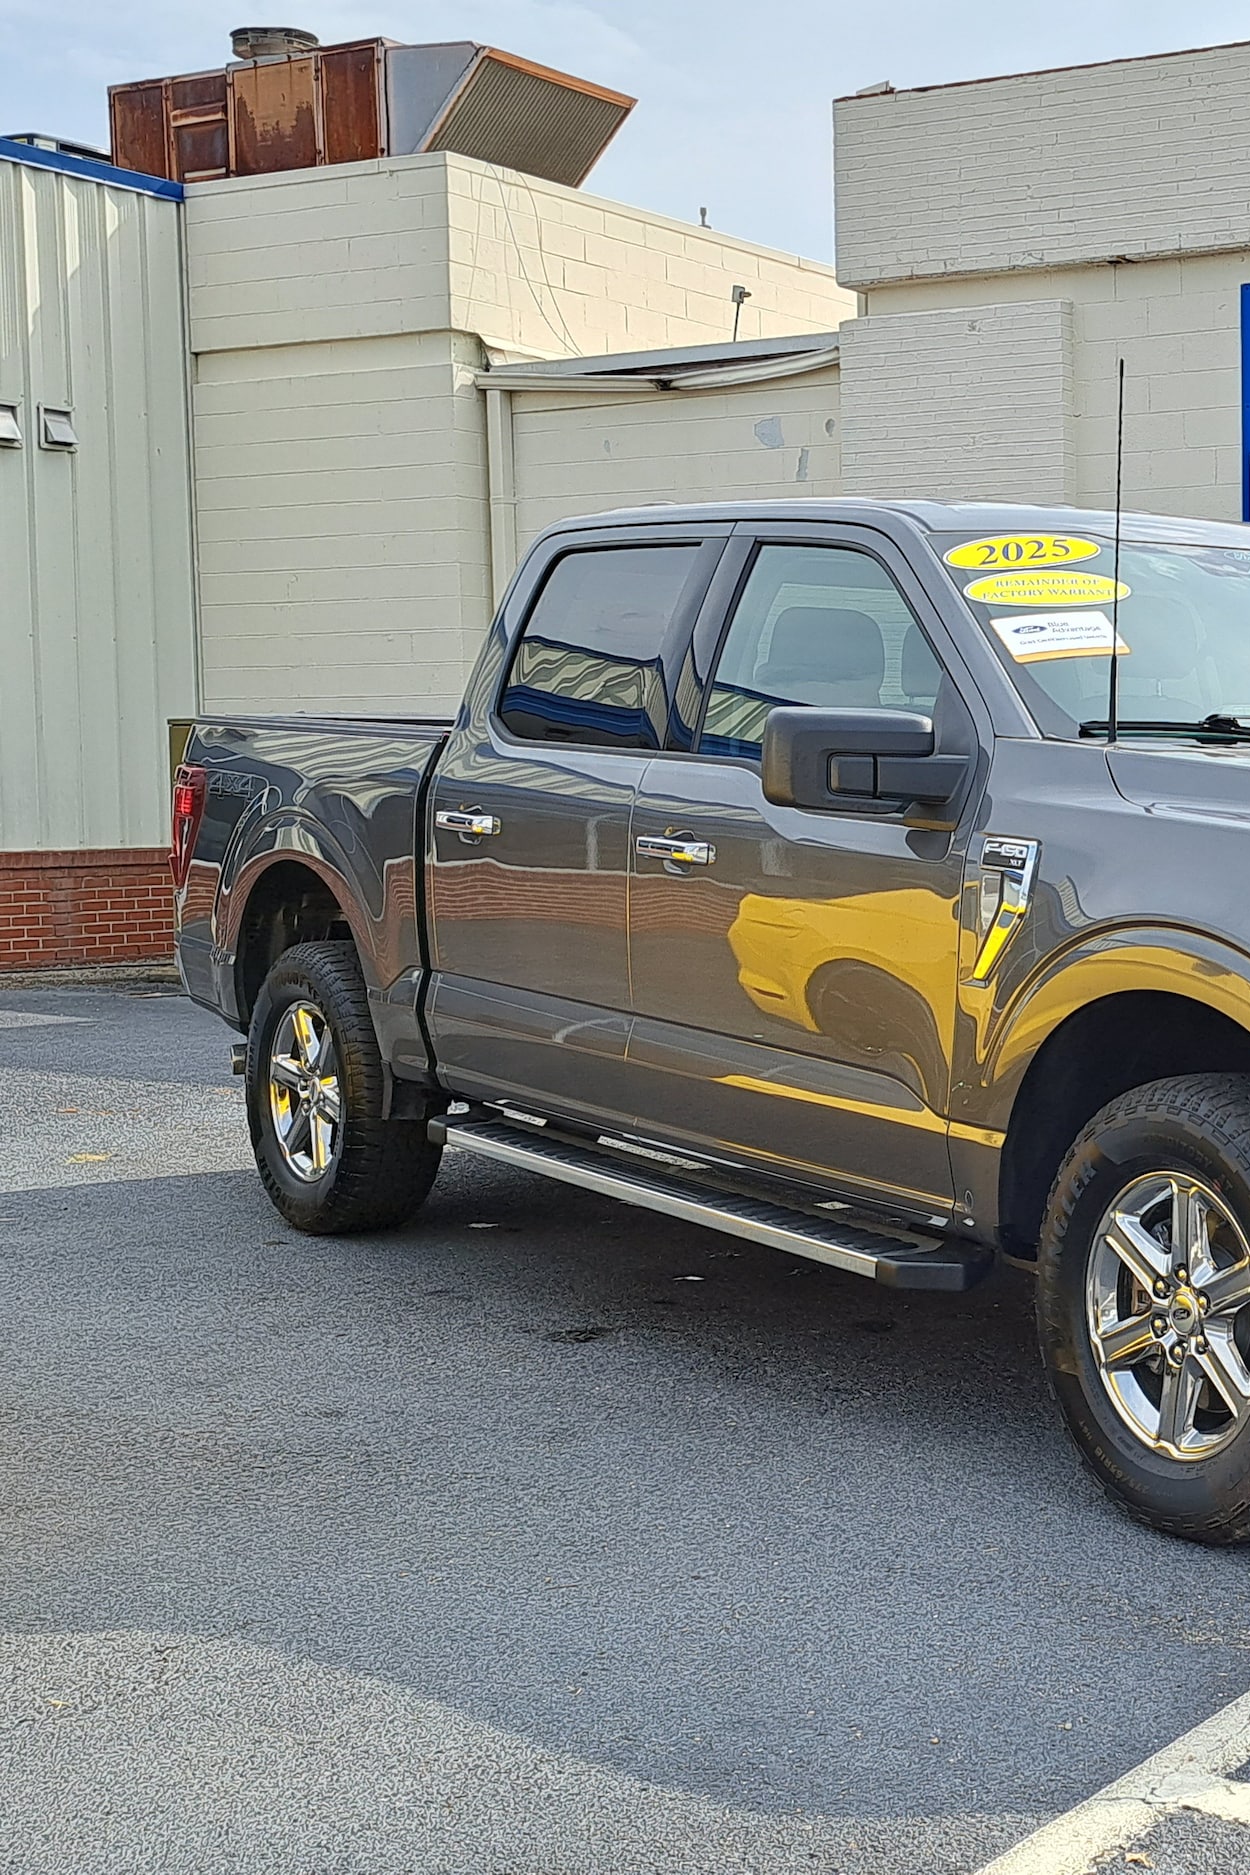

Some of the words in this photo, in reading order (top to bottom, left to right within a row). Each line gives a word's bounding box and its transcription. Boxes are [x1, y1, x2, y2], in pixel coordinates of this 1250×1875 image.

[977, 539, 1070, 566] 2025
[995, 578, 1078, 587] REMAINDER
[1082, 578, 1099, 586] OF
[982, 588, 1044, 599] FACTORY
[1047, 588, 1117, 597] WARRANT
